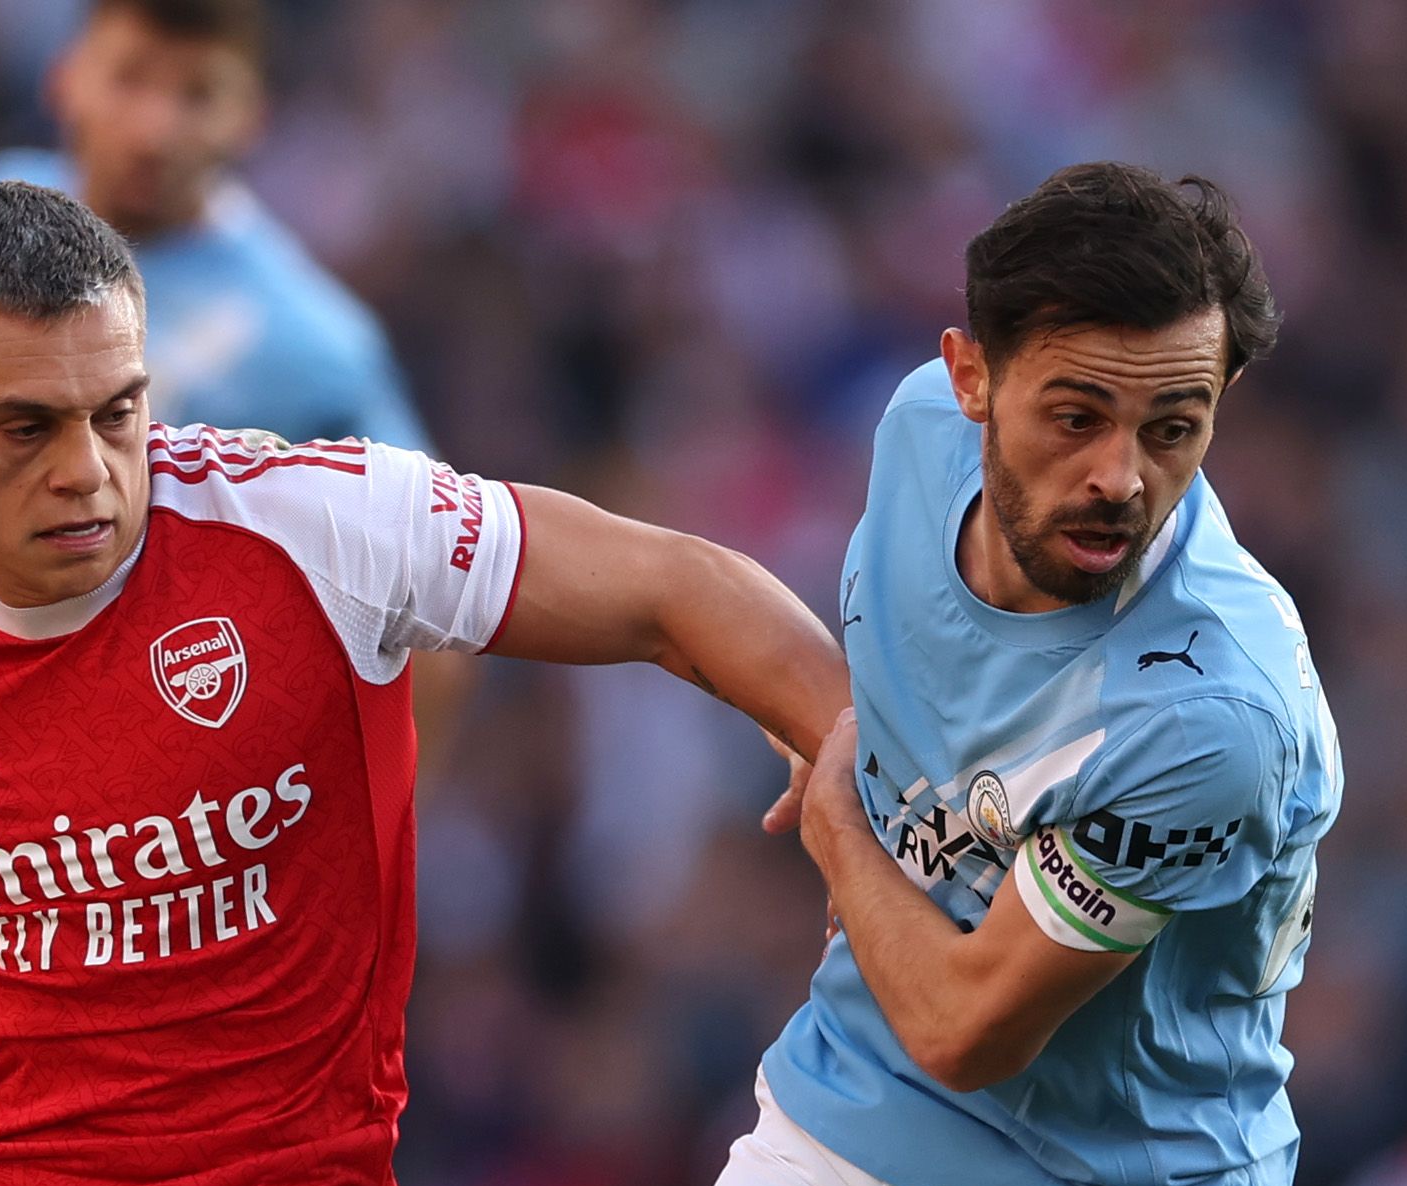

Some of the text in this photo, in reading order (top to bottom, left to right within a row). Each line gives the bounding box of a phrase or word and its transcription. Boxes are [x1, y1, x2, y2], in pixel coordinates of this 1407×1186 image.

[430, 463, 458, 513] VIS
[163, 631, 228, 668] Arsenal
[84, 863, 277, 967] BETTER
